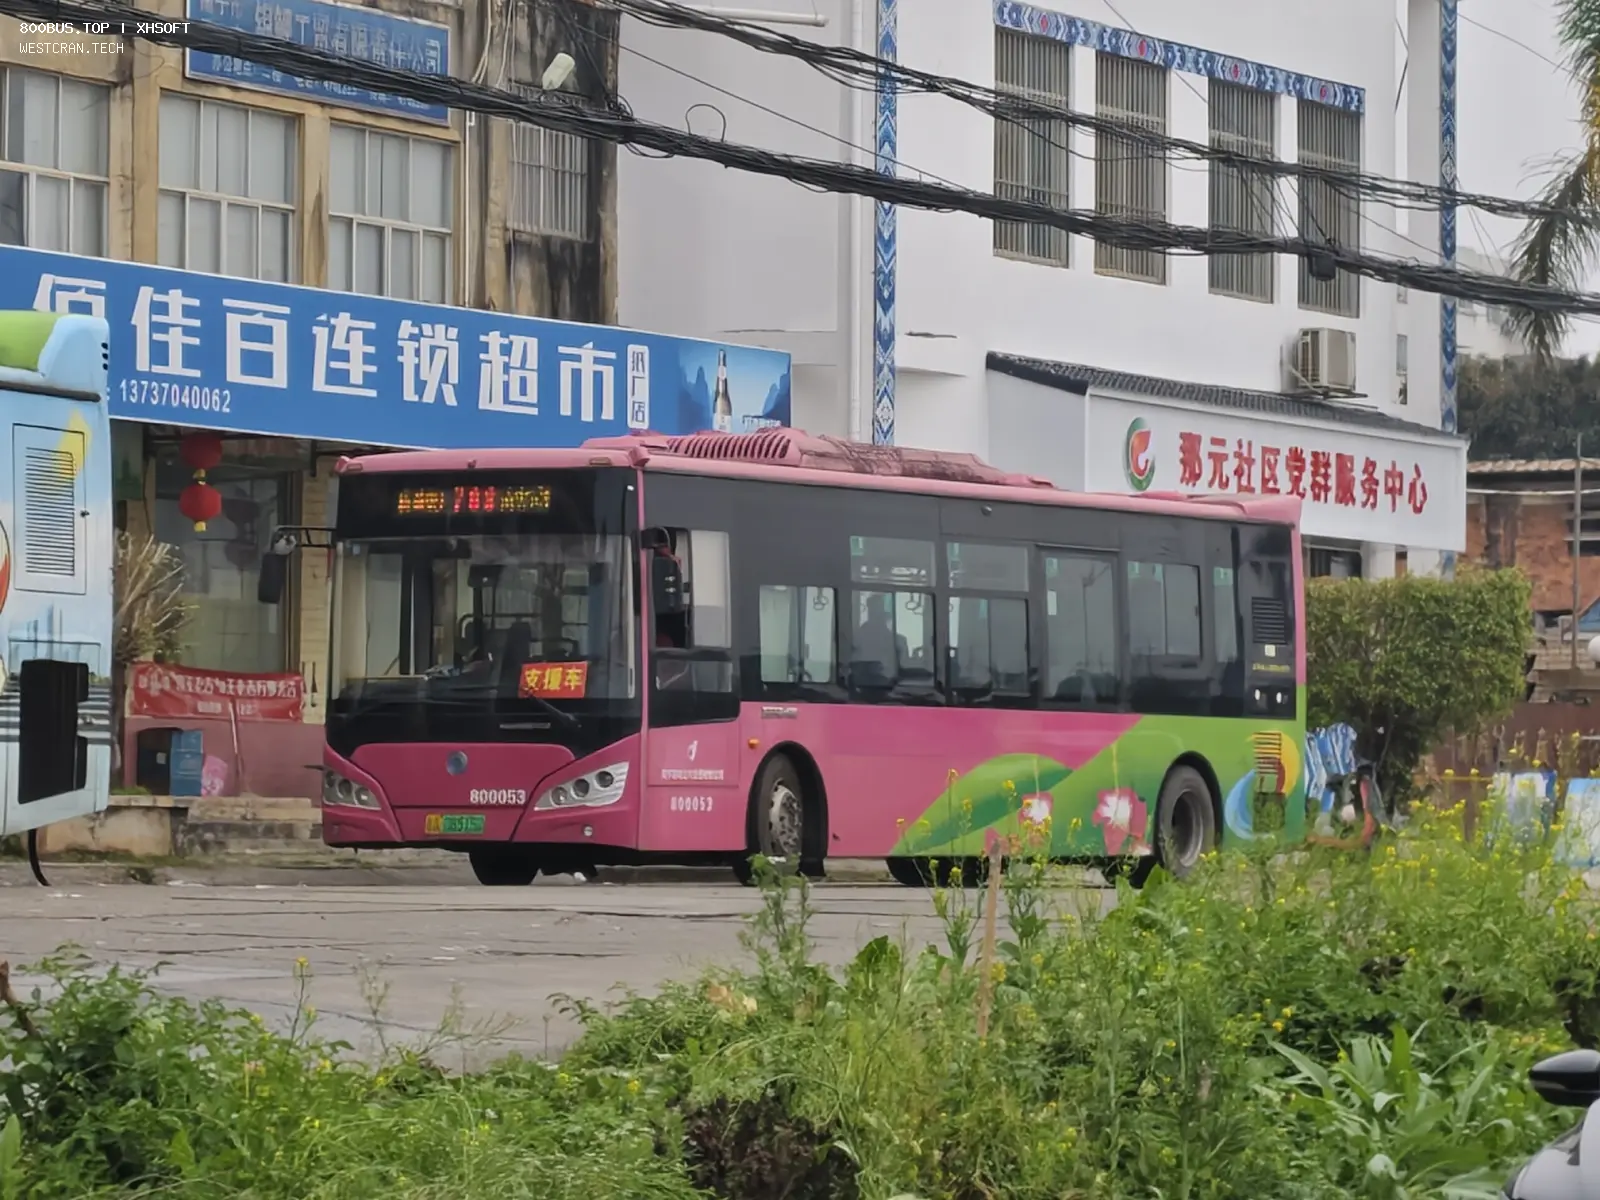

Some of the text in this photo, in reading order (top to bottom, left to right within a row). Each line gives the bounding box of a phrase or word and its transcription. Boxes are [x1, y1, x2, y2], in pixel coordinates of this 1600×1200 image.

[120, 379, 231, 413] 13737040062
[1179, 432, 1428, 514] 那元社区党群服务中心
[470, 788, 526, 805] 800053
